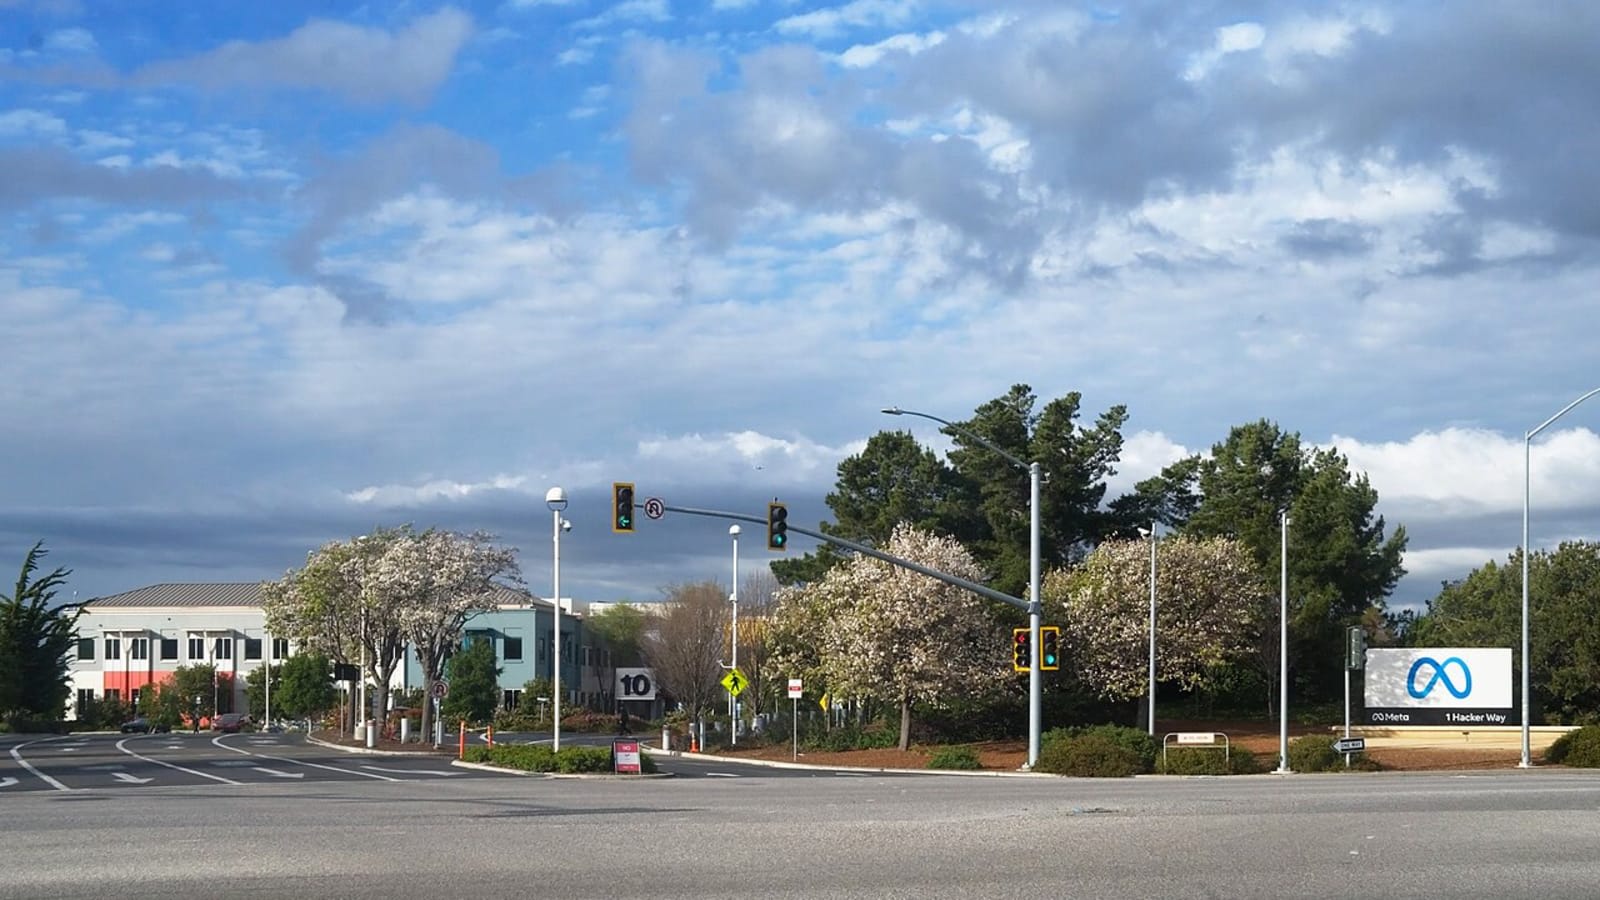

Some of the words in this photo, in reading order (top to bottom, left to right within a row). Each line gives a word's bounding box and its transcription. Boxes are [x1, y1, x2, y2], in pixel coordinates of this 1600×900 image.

[620, 674, 651, 696] 10
[1385, 713, 1410, 721] Meta
[1445, 713, 1451, 721] 1
[1452, 713, 1484, 722] Hacker
[1485, 713, 1506, 724] Way
